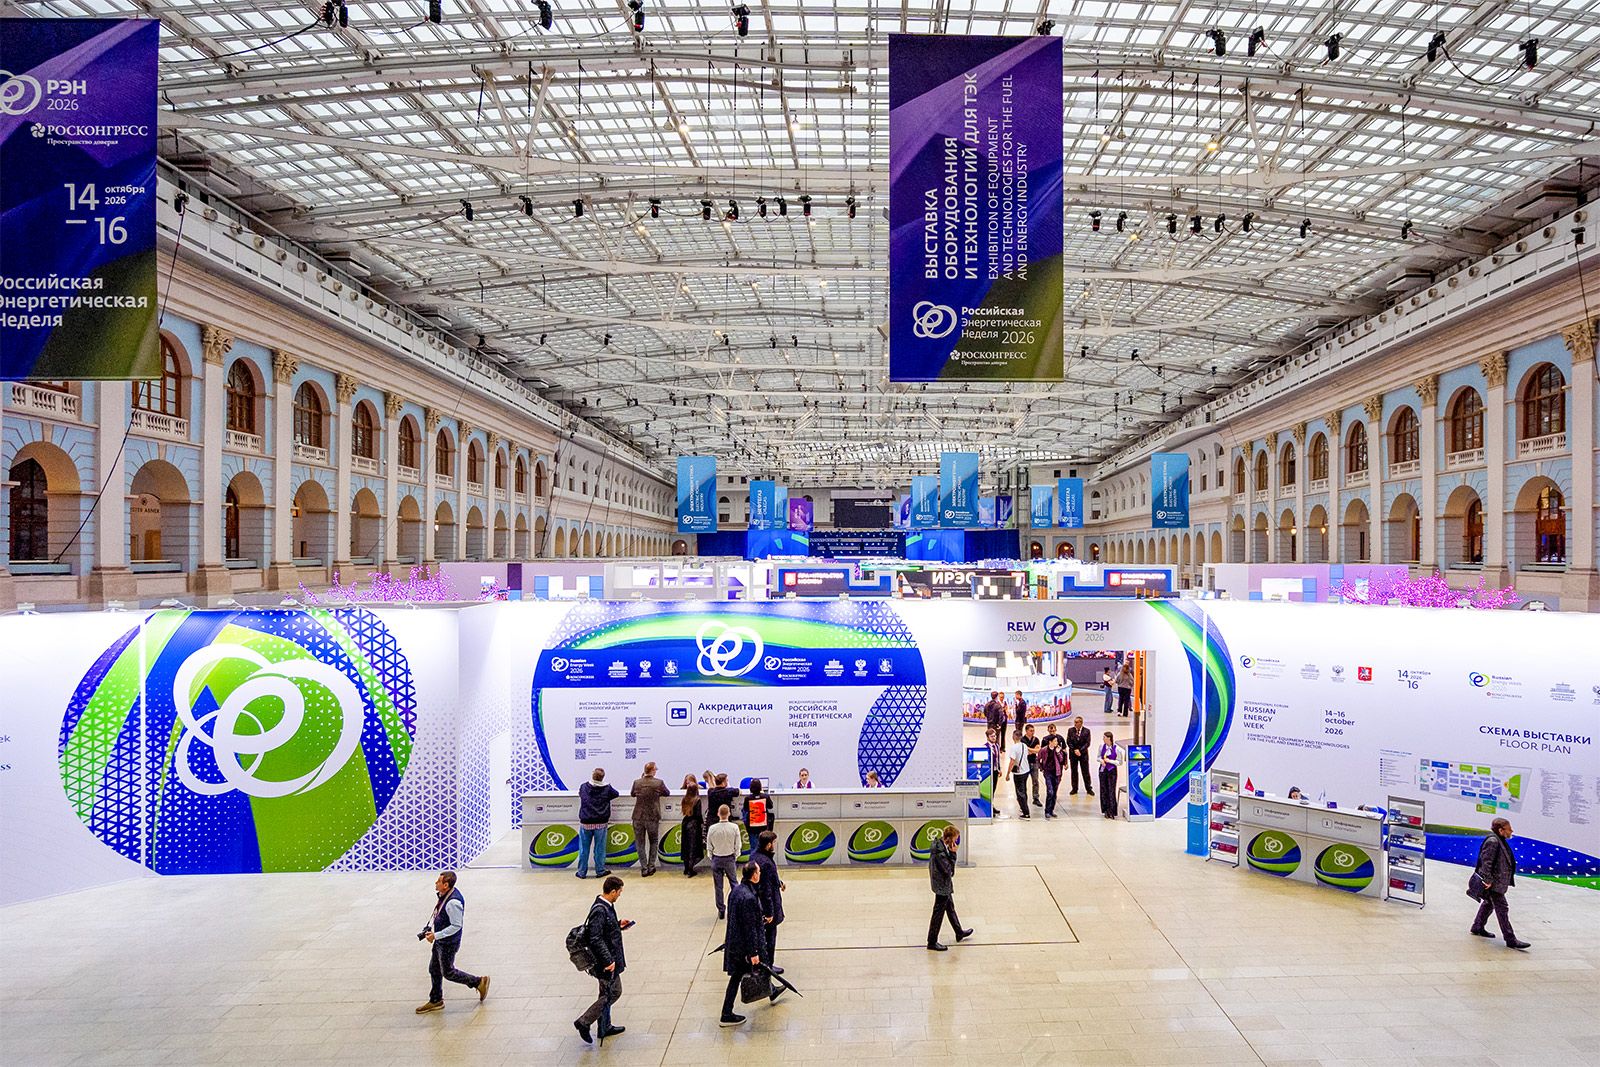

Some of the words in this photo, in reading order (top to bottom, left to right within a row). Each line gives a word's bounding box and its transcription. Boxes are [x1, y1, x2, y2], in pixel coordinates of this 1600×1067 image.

[47, 80, 86, 94] РЭН
[964, 72, 978, 106] ТЭК
[1003, 74, 1012, 104] FUEL
[47, 98, 79, 110] 2026
[1003, 106, 1012, 130] THE
[47, 125, 148, 136] РОСКОНГРЕСС
[964, 108, 980, 144] ДЛЯ
[1003, 132, 1012, 156] FOR
[988, 116, 1000, 190] EQUIPMENT
[1017, 142, 1028, 202] INDUSTRY
[64, 183, 100, 210] 14
[104, 184, 145, 196] октября
[104, 196, 126, 204] 2026
[962, 148, 978, 265] ТЕХНОЛОГИЙ
[988, 192, 998, 209] OF
[1003, 159, 1013, 252] TECHNOLOGIES
[944, 138, 960, 280] ОБОРУДОВАНИЯ
[924, 188, 938, 278] ВЫСТАВКА
[1017, 203, 1028, 251] ENERGY
[988, 211, 998, 280] EXHIBITION
[964, 267, 978, 280] И
[1003, 253, 1013, 280] AND
[1017, 253, 1028, 280] AND
[961, 306, 1024, 316] Российская
[961, 318, 1042, 329] Энергетическая
[961, 330, 998, 340] Неделя
[1002, 330, 1035, 344] 2026
[961, 352, 1027, 360] РОСКОНГРЕСС
[1007, 622, 1036, 631] REW
[1085, 622, 1110, 631] РЭН
[1007, 634, 1028, 642] 2026
[1085, 634, 1105, 642] 2026
[1398, 670, 1408, 679] 14
[698, 702, 773, 711] Аккредитация
[1244, 706, 1276, 714] RUSSIAN
[698, 716, 762, 725] Accreditation
[1244, 714, 1273, 722] ENERGY
[1325, 718, 1355, 726] october
[1325, 727, 1343, 735] 2026
[1479, 726, 1520, 737] СХЕМА
[1523, 730, 1591, 744] ВЫСТАВКИ
[1500, 739, 1538, 750] FLOOR
[1542, 744, 1571, 754] PLAN
